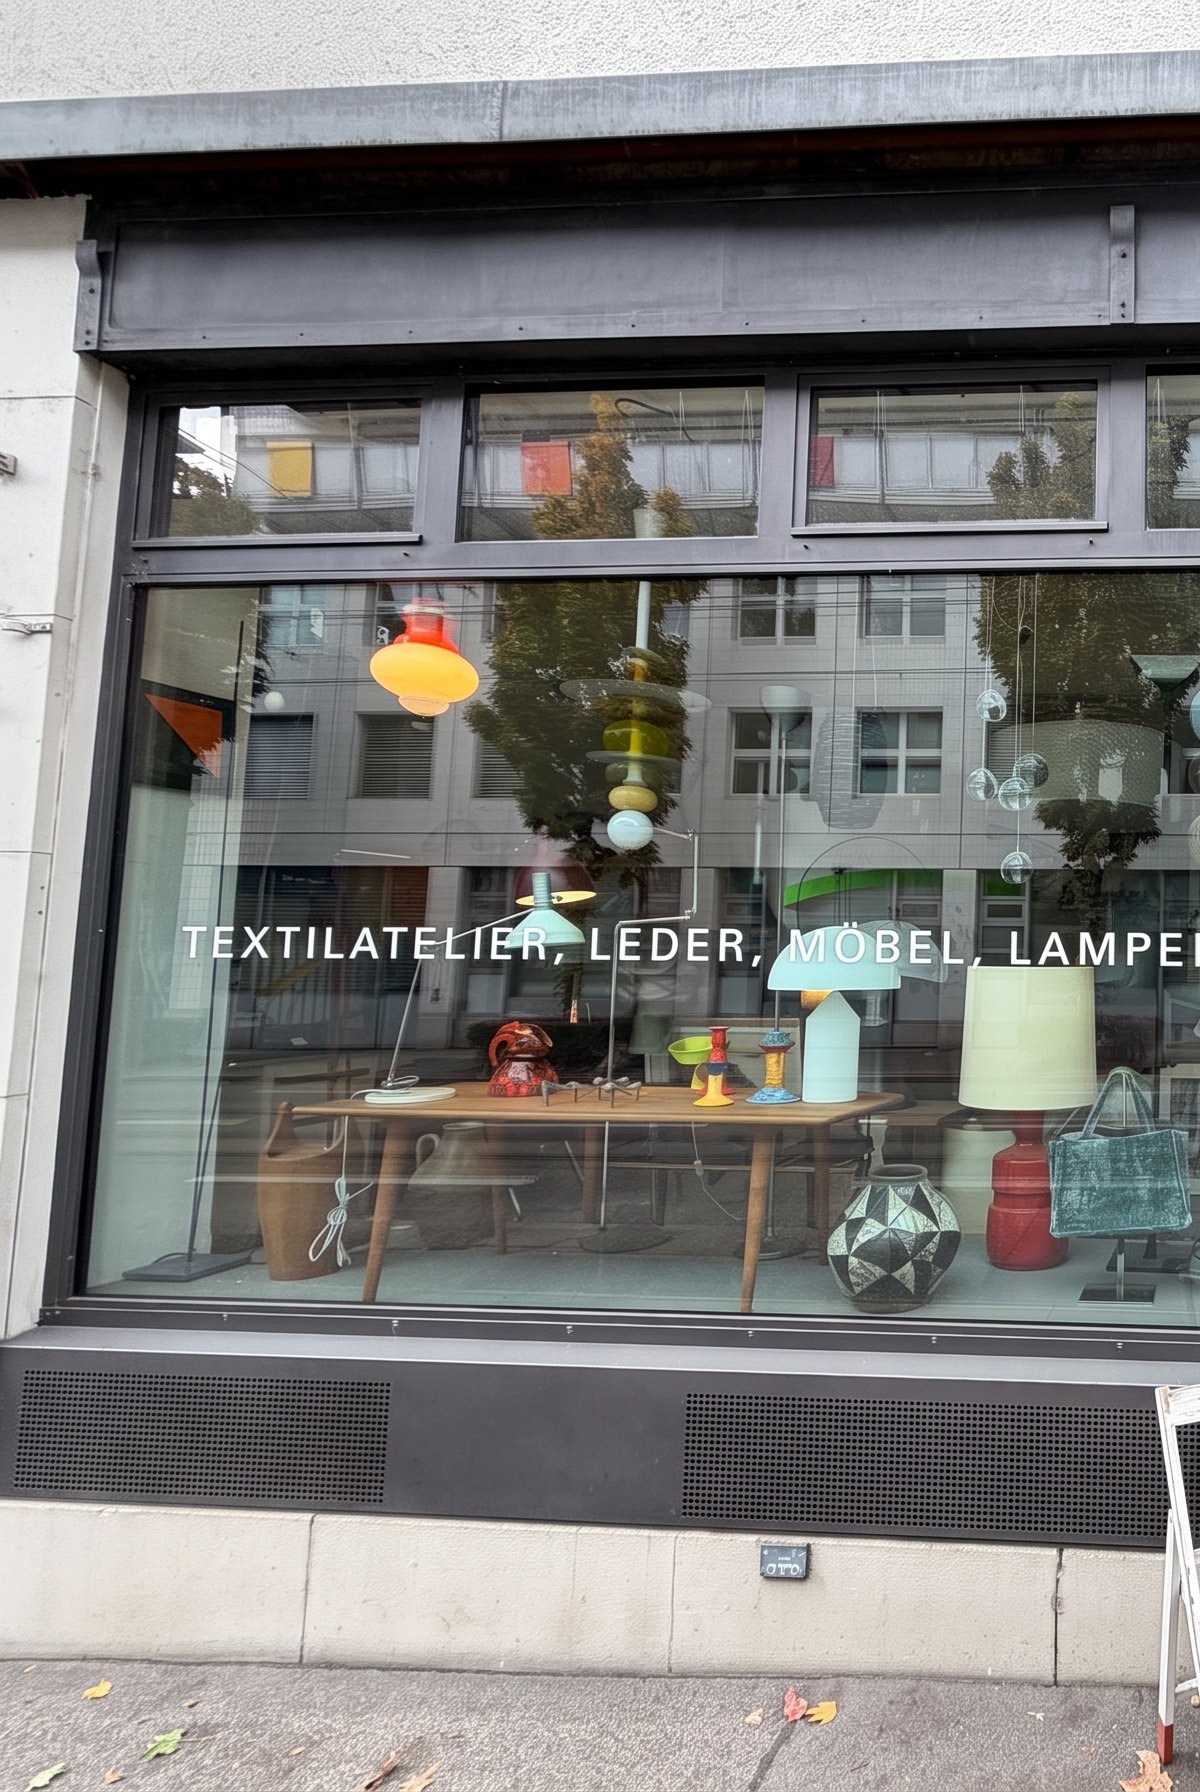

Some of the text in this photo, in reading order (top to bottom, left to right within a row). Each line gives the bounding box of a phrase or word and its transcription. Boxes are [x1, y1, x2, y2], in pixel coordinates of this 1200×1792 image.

[181, 925, 564, 966] TEXTILATELIER,
[589, 927, 761, 968] LEDER,
[788, 921, 983, 970] MÖBEL,
